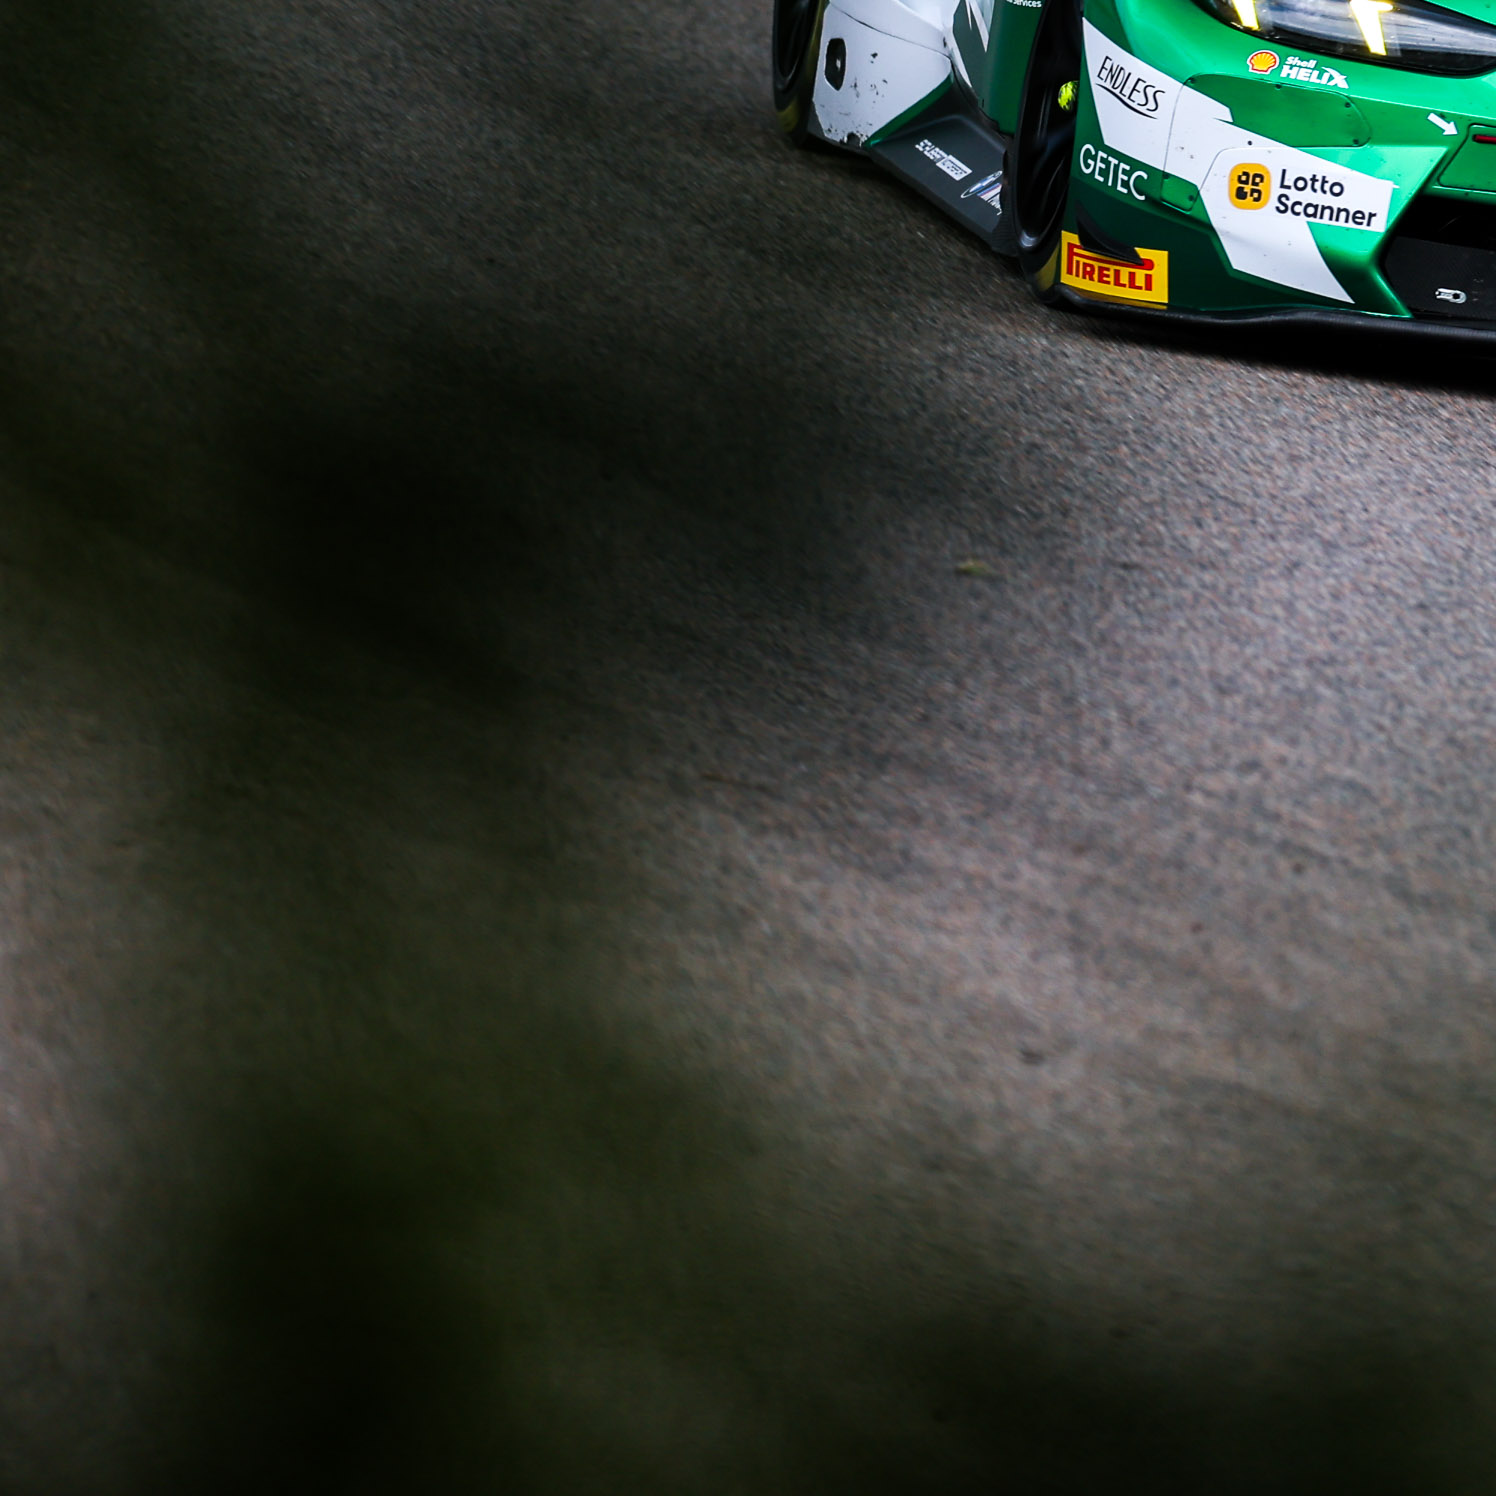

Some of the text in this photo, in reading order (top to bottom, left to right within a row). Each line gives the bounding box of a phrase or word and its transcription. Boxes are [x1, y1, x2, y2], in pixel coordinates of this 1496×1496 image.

[1280, 65, 1349, 89] HELIX
[1285, 56, 1317, 68] Shell
[1097, 55, 1166, 112] ENDLESS
[1079, 143, 1148, 201] GETEC
[1279, 168, 1345, 198] Lotto
[1275, 193, 1377, 228] Scanner
[1066, 241, 1155, 292] PIRELLI
